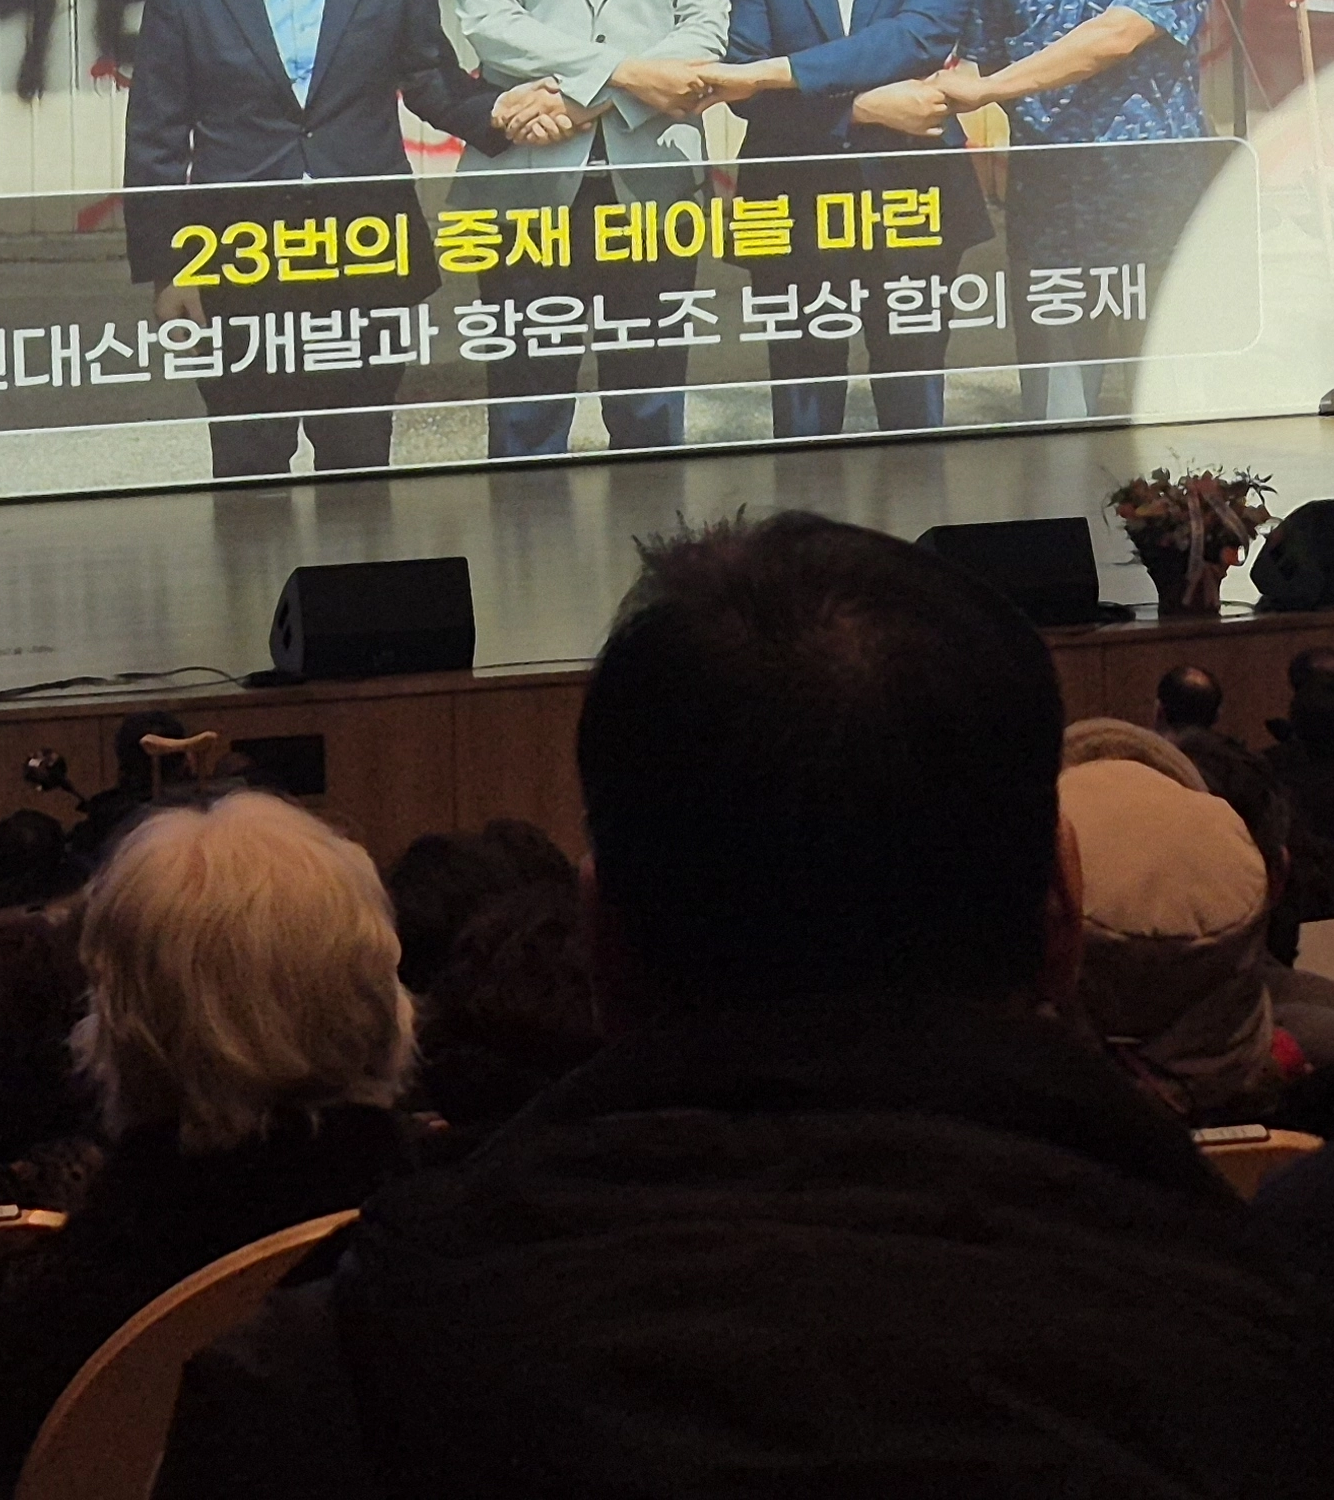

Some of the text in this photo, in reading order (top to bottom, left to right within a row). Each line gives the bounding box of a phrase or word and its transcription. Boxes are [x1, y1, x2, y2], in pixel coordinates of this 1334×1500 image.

[169, 185, 946, 289] 23번의 중재 테이블 마련
[452, 287, 722, 363] 항운노조
[739, 274, 871, 344] 보상
[881, 270, 1009, 336] 합의
[1026, 262, 1150, 327] 중재
